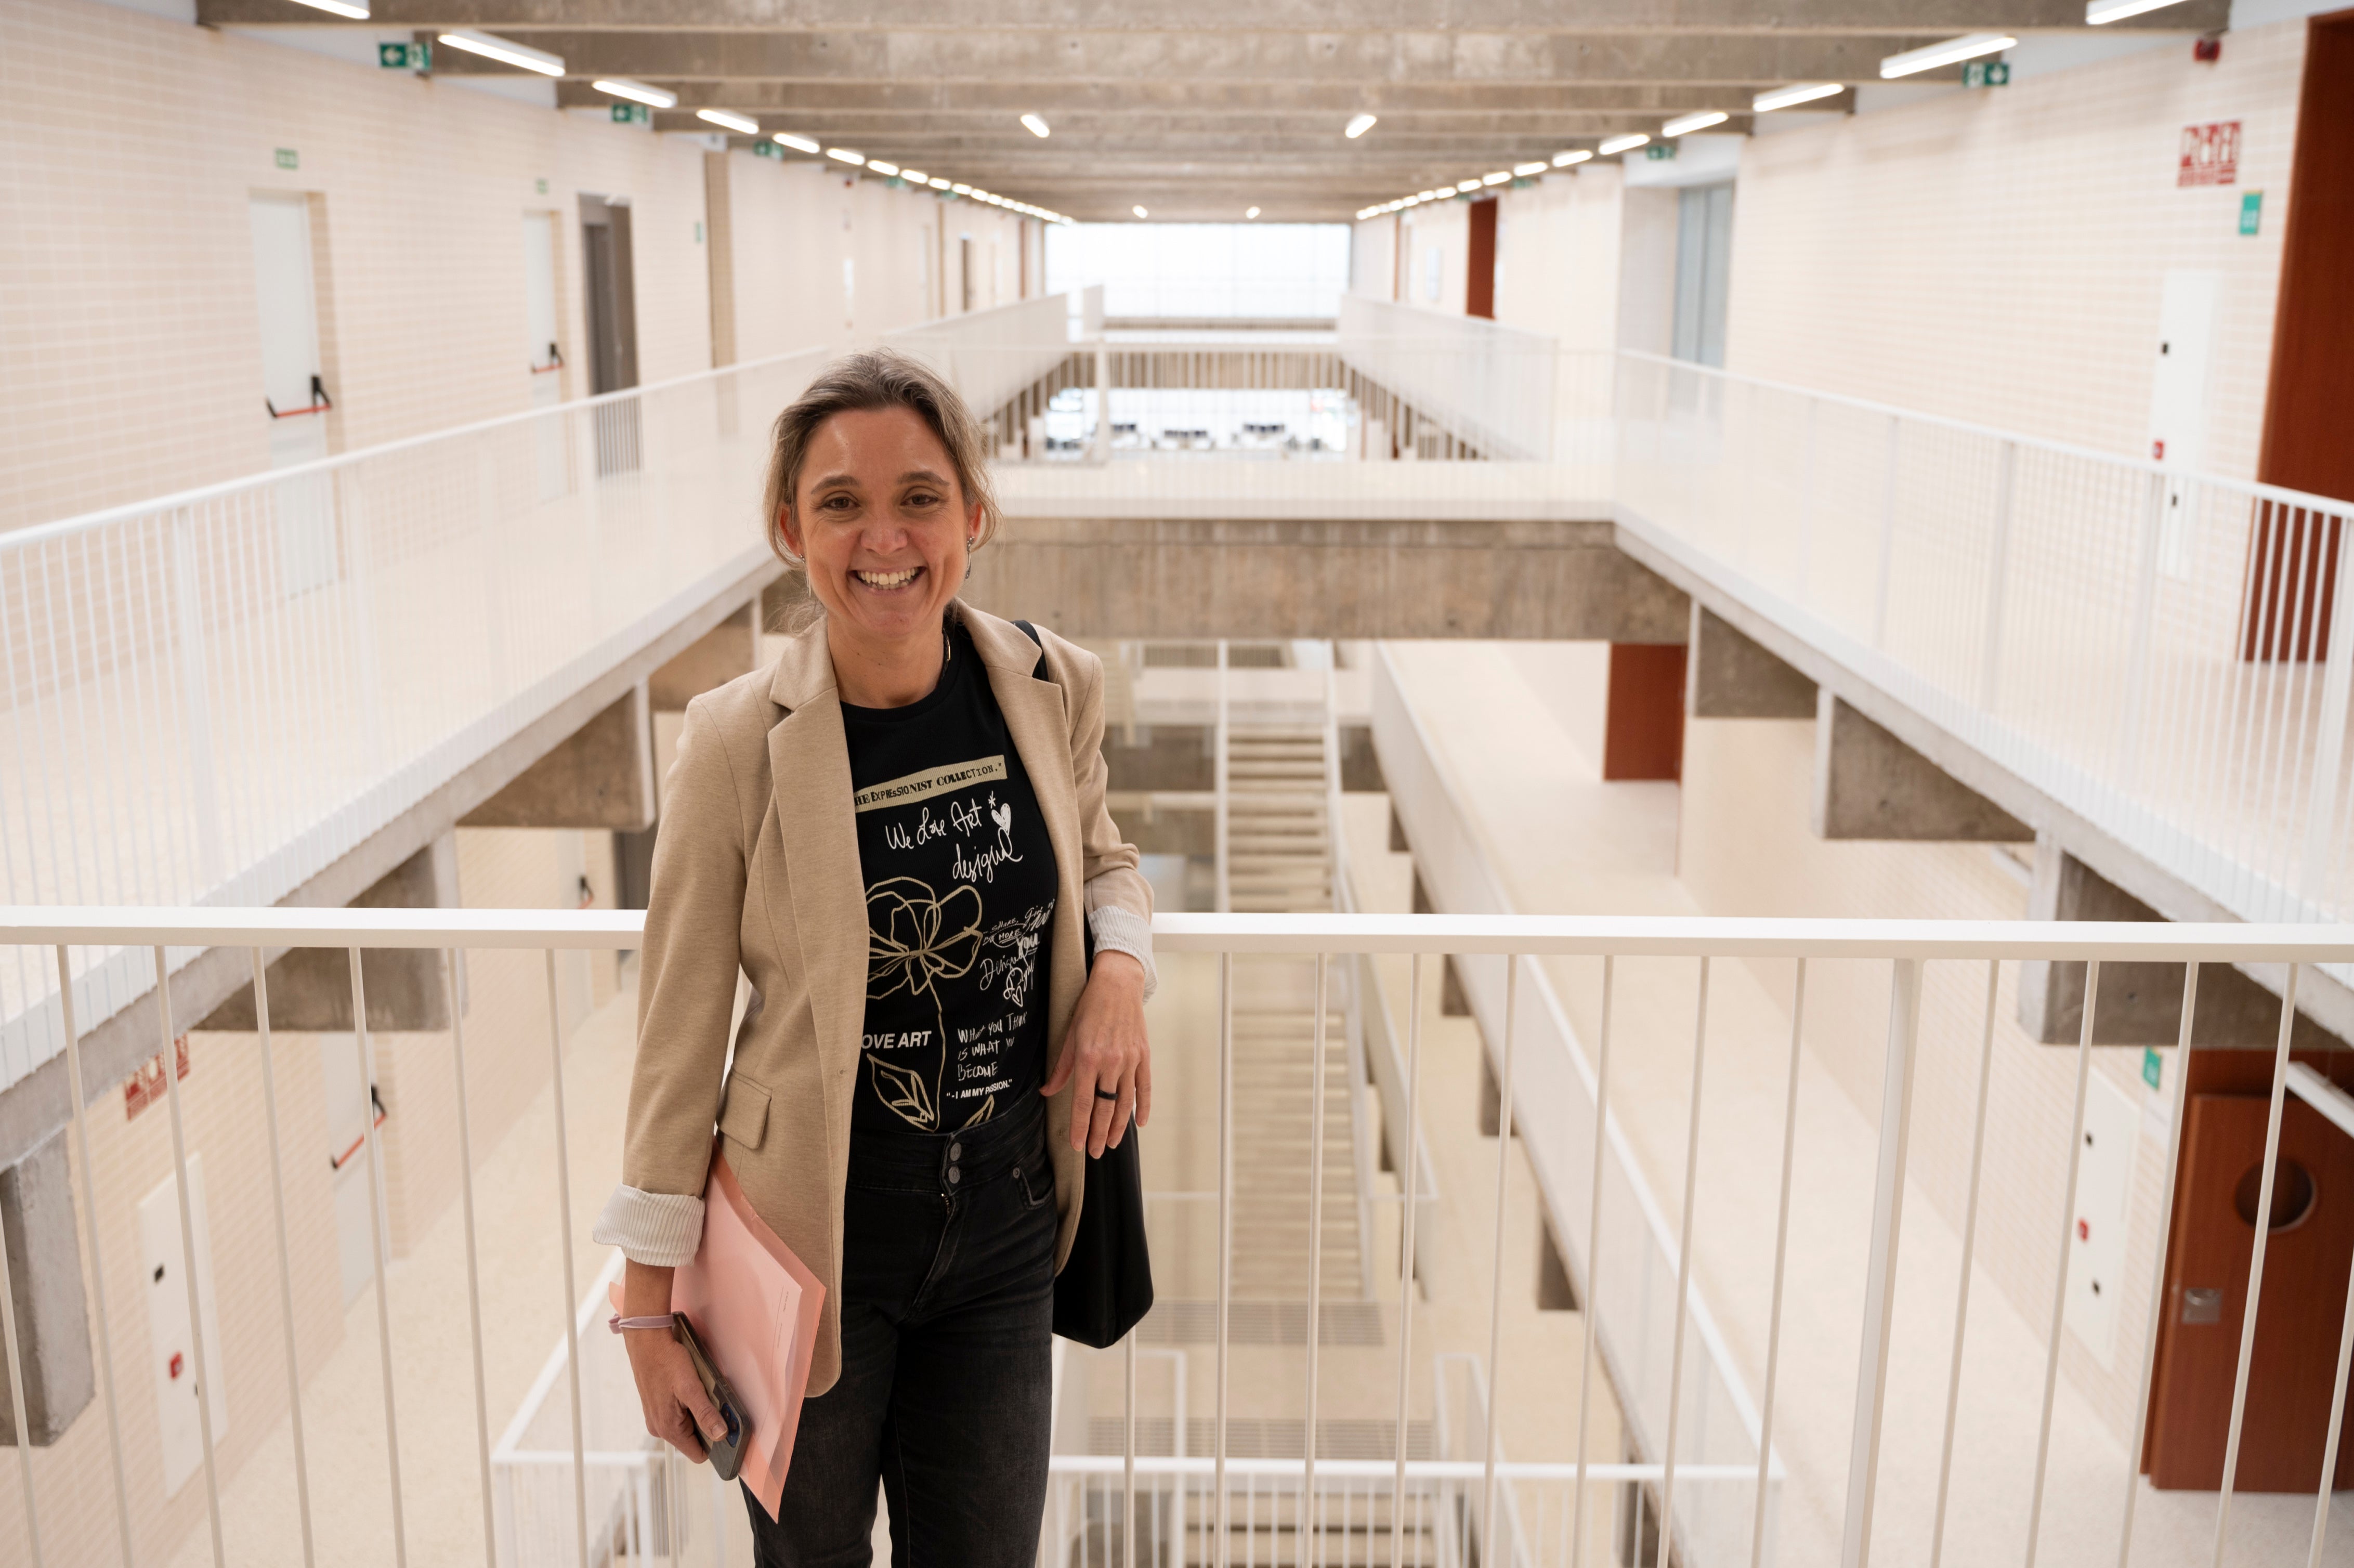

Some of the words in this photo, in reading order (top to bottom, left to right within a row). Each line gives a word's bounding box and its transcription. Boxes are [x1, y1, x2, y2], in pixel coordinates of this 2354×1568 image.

[885, 822, 914, 850] We
[917, 807, 947, 845] Love
[897, 1030, 932, 1048] ART
[958, 1048, 968, 1061] IS
[972, 1040, 1000, 1056] WHAT
[957, 1062, 998, 1081] BECOME
[960, 1089, 971, 1099] AM
[972, 1087, 984, 1096] MY
